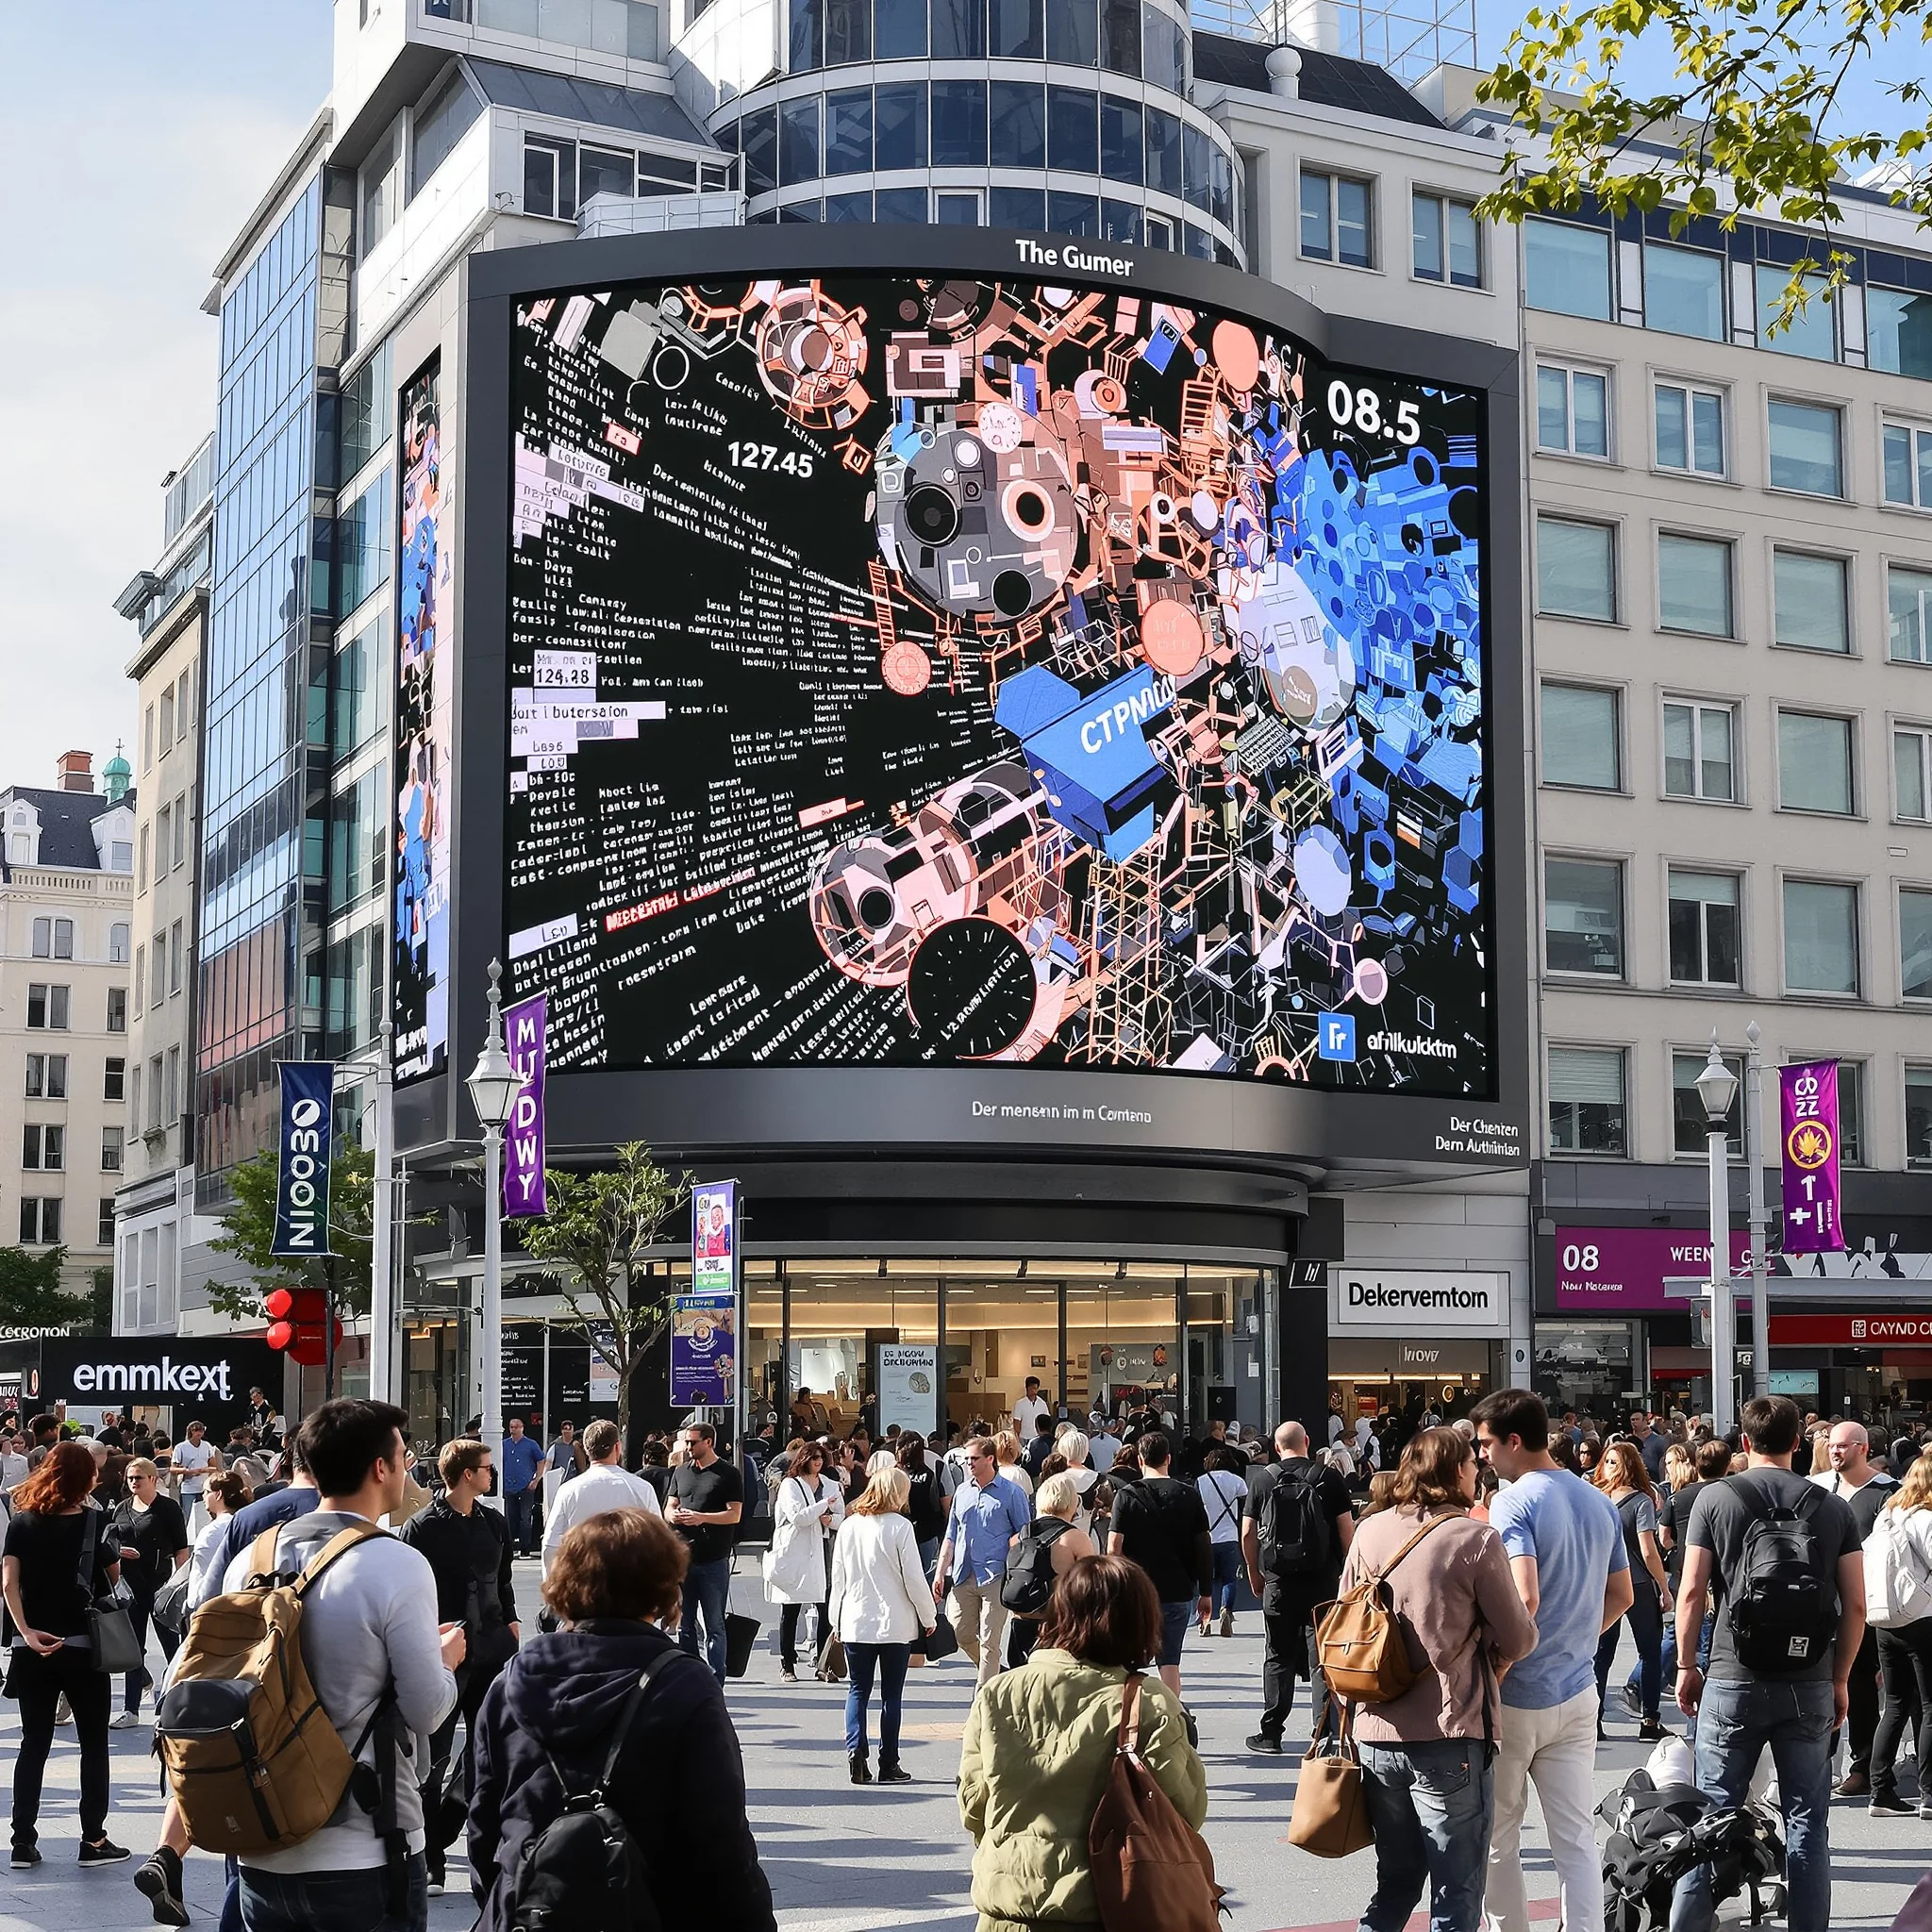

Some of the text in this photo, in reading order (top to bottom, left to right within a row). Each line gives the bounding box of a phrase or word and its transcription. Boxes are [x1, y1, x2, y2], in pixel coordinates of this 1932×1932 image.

[1014, 239, 1134, 277] The Gumer
[1327, 380, 1421, 445] 08.5
[727, 441, 814, 478] 127.45
[972, 1101, 997, 1117] Der
[1562, 1244, 1599, 1272] 08
